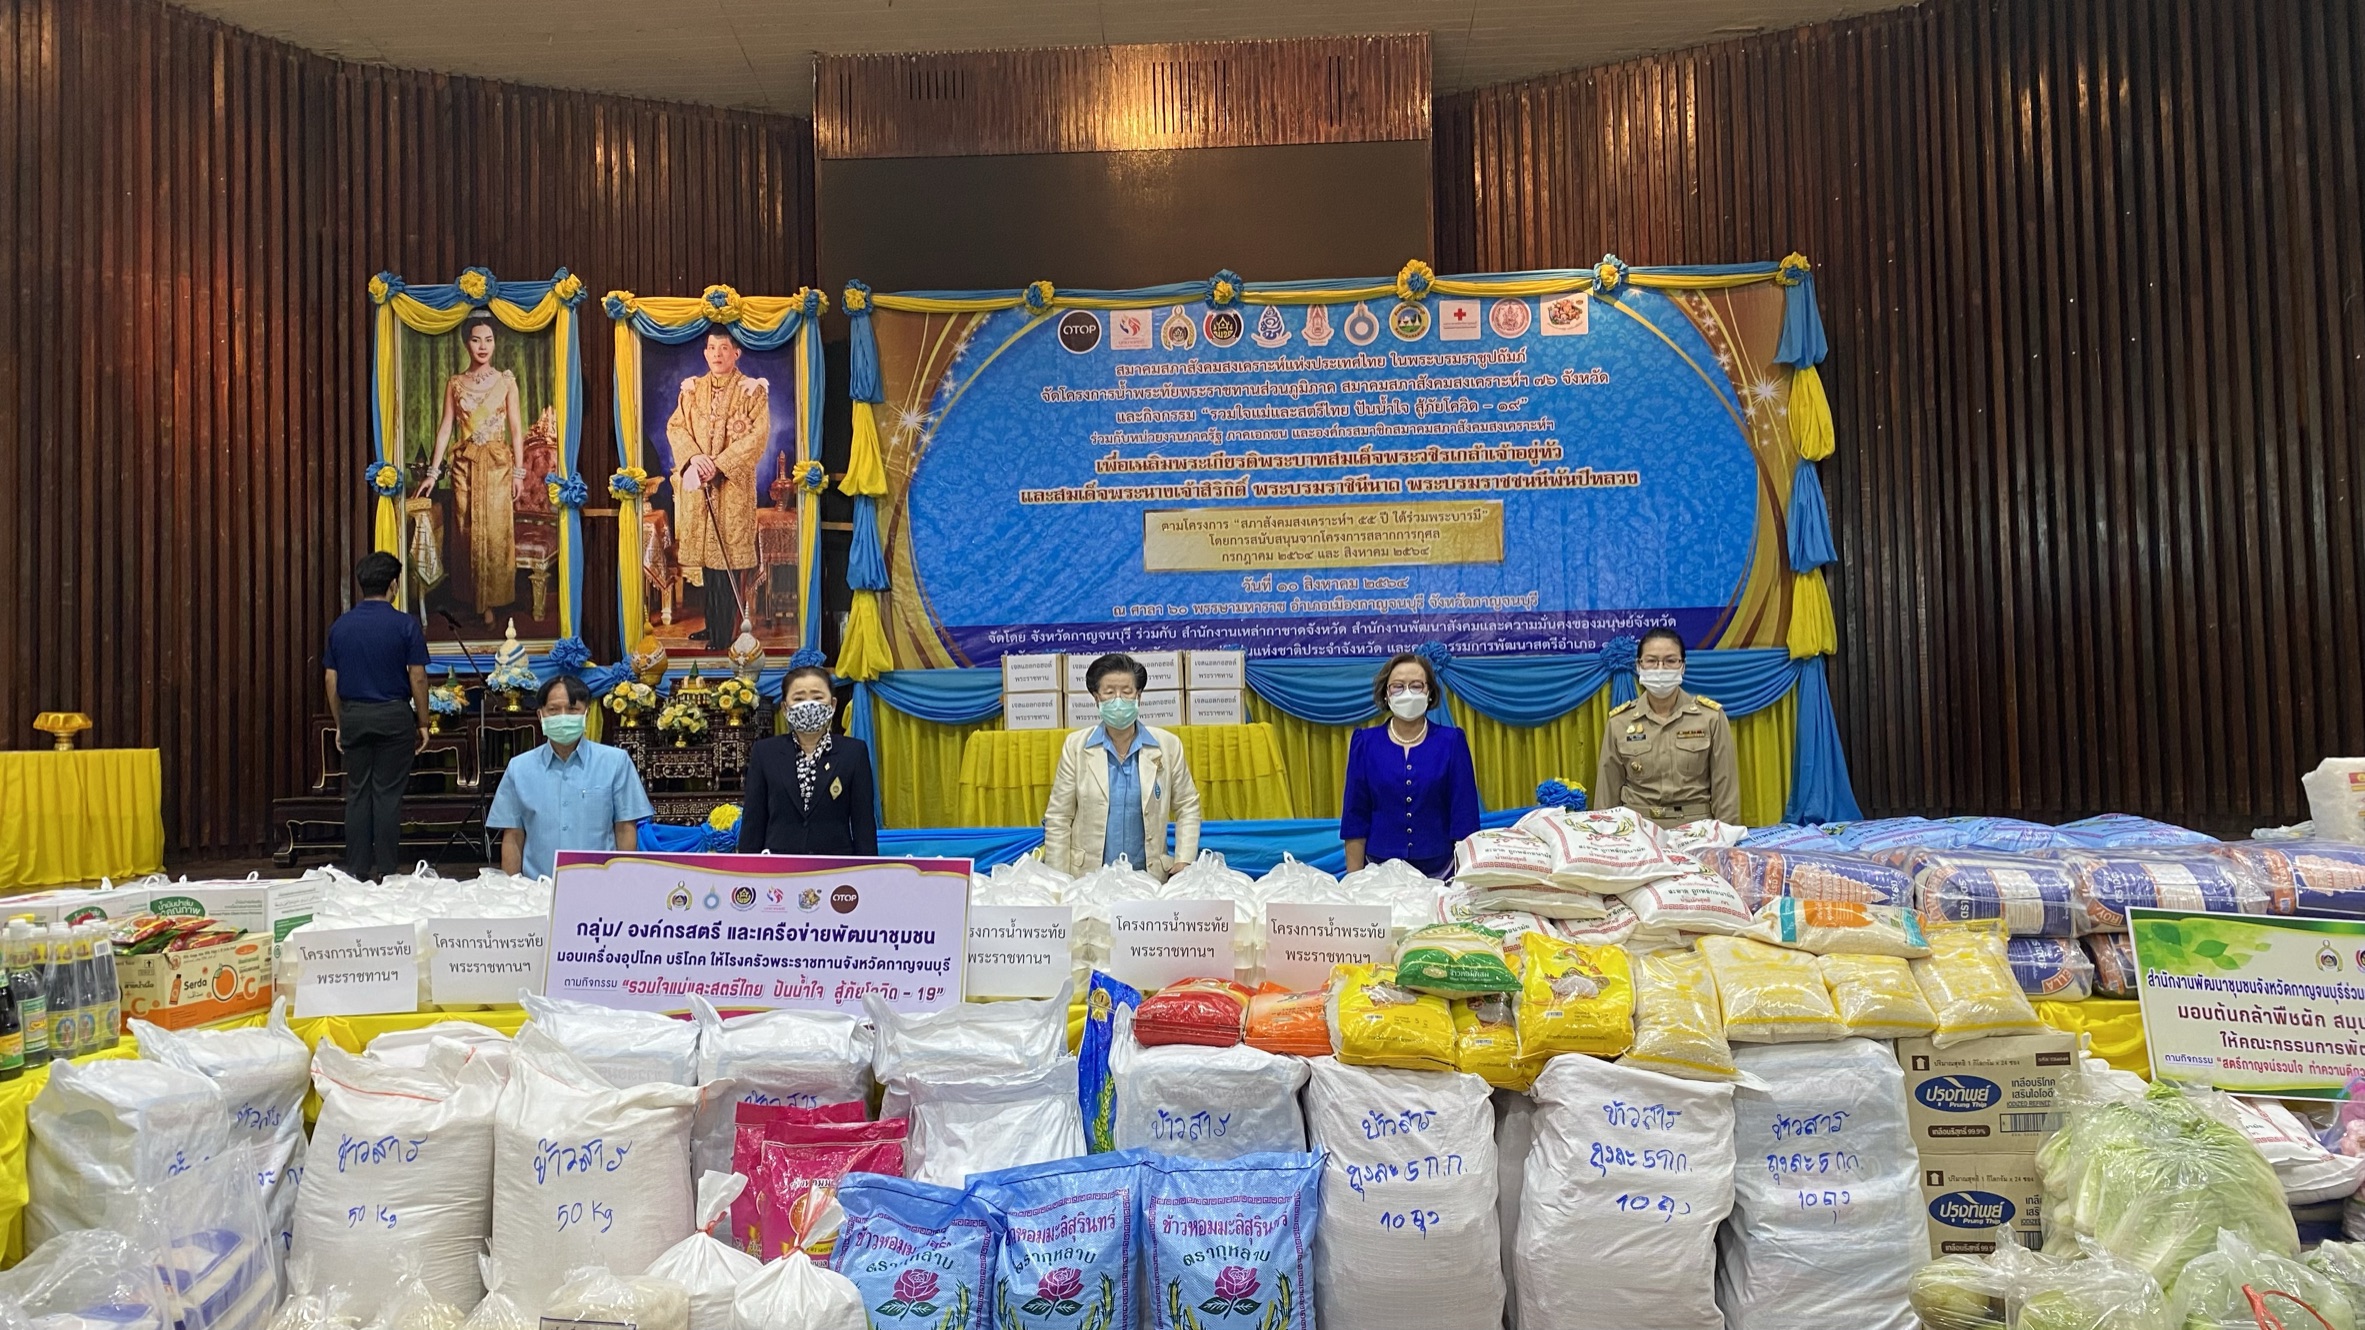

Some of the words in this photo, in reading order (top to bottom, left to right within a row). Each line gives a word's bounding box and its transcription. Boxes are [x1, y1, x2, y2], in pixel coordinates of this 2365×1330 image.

[1063, 324, 1097, 336] OTOP
[1116, 353, 1385, 377] สมาคมสภาสังคมสงเคราะห์แห่งประเทศไทย
[1390, 347, 1526, 369] ในพระบรมราชูปถัมภ์
[1041, 378, 1336, 402] จัดโครงการน้ำพระทัยพระราชทานส่วนภูมิภาค
[1341, 373, 1528, 394] สมาคมสภาสังคมสงเคราะห์ฯ
[1534, 375, 1557, 386] ๗๖
[1562, 368, 1610, 386] จังหวัด
[1116, 405, 1196, 423] และกิจกรรม
[1354, 395, 1409, 416] ปันน้ำใจ
[1415, 396, 1479, 419] สู้ภัยโควิด
[1090, 428, 1222, 446] ร่วมกับหน่วยงานภาครัฐ
[1226, 429, 1287, 441] ภาคเอกชน
[1292, 419, 1555, 439] และองค์กรสมาชิกสมาคมสภาสังคมสงเคราะห์ฯ
[1020, 475, 1250, 504] และสมเด็จพระนางเจ้าสิริกิติ์
[1252, 475, 1401, 499] พระบรมราชินีนาถ
[1407, 466, 1640, 492] พระบรมราชชนนีพันปีหลวง
[1161, 518, 1229, 532] ตามโครงการ
[1380, 511, 1389, 524] ปี
[1210, 529, 1440, 547] โดยการสนับสนุนจากโครงการสลากการกุศล
[1222, 551, 1274, 565] กรกฎาคม
[1318, 550, 1339, 559] และ
[1344, 546, 1389, 559] สิงหาคม
[1242, 574, 1272, 592] วันที่
[1277, 581, 1298, 592] ๑๐
[1303, 575, 1358, 592] สิงหาคม
[1113, 606, 1126, 617] ณ
[1130, 603, 1163, 616] ศาลา
[1193, 599, 1285, 615] พรรษามหาราช
[1291, 594, 1425, 613] อำเภอเมืองกาญจนบุรี
[1429, 591, 1539, 609] จังหวัดกาญจนบุรี
[988, 630, 1026, 643] จัดโดย
[1031, 626, 1131, 645] จังหวัดกาญจนบุรี
[1136, 625, 1177, 640] ร่วมกับ
[1182, 622, 1347, 639] สำนักงานเหล่ากาชาดจังหวัด
[1352, 613, 1677, 635] สำนักงานพัฒนาสังคมและความมั่นคงของมนุษย์จังหวัด
[833, 893, 857, 903] OTOP
[576, 917, 623, 943] กลุ่ม/
[628, 919, 722, 940] องค์กรสตรี
[727, 921, 935, 950] และเครือข่ายพัฒนาชุมชน
[969, 918, 1066, 939] รงการน้ำพระทัย
[1116, 912, 1230, 934] โครงการน้ำพระทัย
[1270, 917, 1386, 940] โครงการน้ำพระทัย
[301, 939, 411, 961] โครงการน้ำพระทัย
[433, 930, 543, 949] โครงการน้ำพระทัย
[557, 945, 662, 968] มอบเครื่องอุปโภค
[666, 951, 706, 966] บริโภค
[710, 951, 951, 976] ให้โรงครัวพระราชทานจังหวัดกาญจนบุรี
[968, 952, 1051, 965] พระราชทานฯ
[1130, 943, 1215, 960] พระราชทานฯ
[1284, 947, 1371, 965] พระราชทานฯ
[317, 970, 399, 984] พระราชทานฯ
[449, 960, 531, 973] พระราชทานฯ
[184, 977, 207, 990] Serda
[564, 977, 617, 988] ตามกิจกรรม
[774, 974, 824, 998] ปันน้ำใจ
[2178, 1002, 2326, 1028] มอบต้นกล้าพืชผัก
[2165, 1053, 2213, 1065] ตามกิจกรรม
[2012, 1077, 2056, 1088] เกลือบริโภค
[2012, 1088, 2056, 1098] เสริมไอโอดี
[1926, 1082, 1991, 1107] ปรุงทิพย์
[1151, 1109, 1232, 1142] ข้าวสาร
[1362, 1110, 1436, 1139] ข้าวสาร
[1603, 1101, 1682, 1130] ข้าวสาร
[1771, 1111, 1850, 1141] ข้าวสาร
[338, 1133, 428, 1173] ข้าวสาร
[534, 1137, 632, 1185] ข้าวสาร
[1819, 1153, 1829, 1173] 5
[1404, 1161, 1418, 1181] 5
[1616, 1194, 1649, 1212] 10
[1798, 1190, 1817, 1209] 10
[1940, 1198, 2005, 1222] ปรุงทิพย์
[348, 1205, 365, 1229] 50
[557, 1202, 582, 1232] 50
[1183, 1243, 1271, 1266] ตรากุหลาบ
